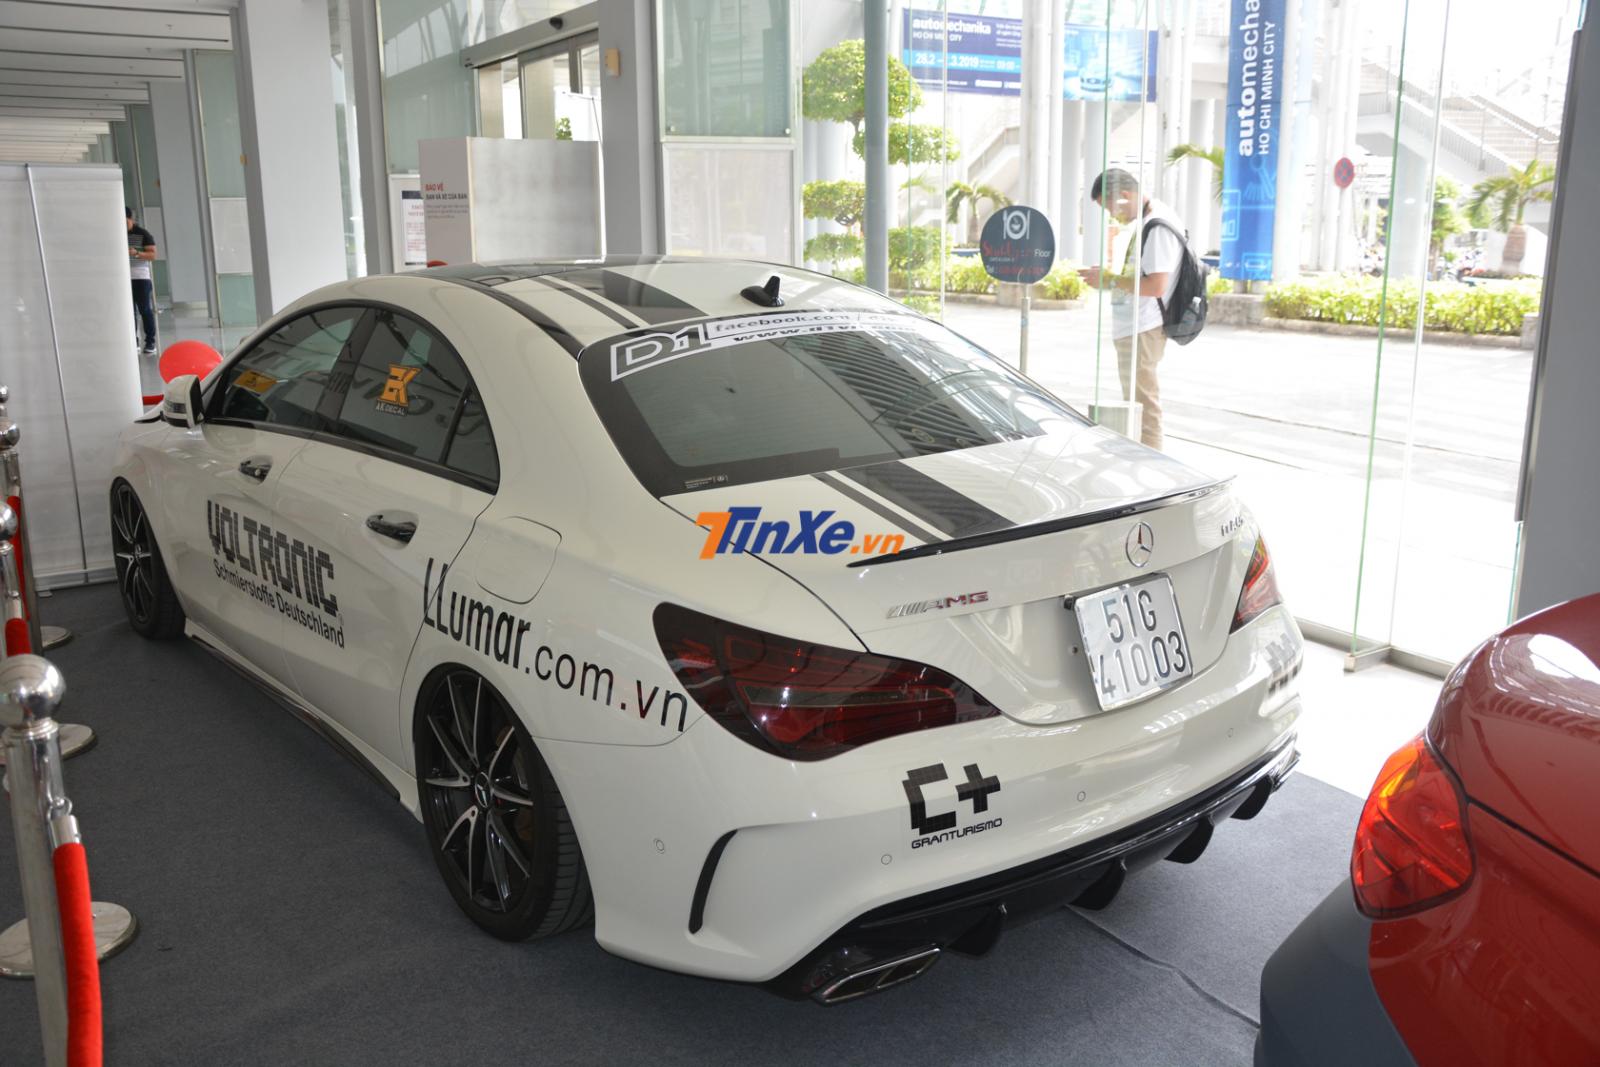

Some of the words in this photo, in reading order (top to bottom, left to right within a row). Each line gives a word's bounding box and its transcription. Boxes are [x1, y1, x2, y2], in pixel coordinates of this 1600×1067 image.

[949, 34, 962, 42] CITY
[1263, 20, 1276, 56] CITY
[915, 53, 935, 65] 28.2
[946, 55, 979, 68] .3.2019
[1237, 0, 1261, 156] automecha
[1261, 58, 1274, 101] MINH
[1259, 104, 1272, 130] CHI
[1258, 134, 1270, 155] HO
[1033, 248, 1051, 258] Floor
[713, 313, 850, 333] facebook.com
[207, 500, 339, 617] VOLTRONIC
[213, 558, 275, 609] Schmierstoffe
[275, 591, 345, 649] Deutschland
[1101, 589, 1157, 644] 51G
[423, 557, 689, 732] LLumar.com.vn
[1097, 630, 1187, 698] 410.03
[911, 817, 1003, 849] GRANTURISMO
